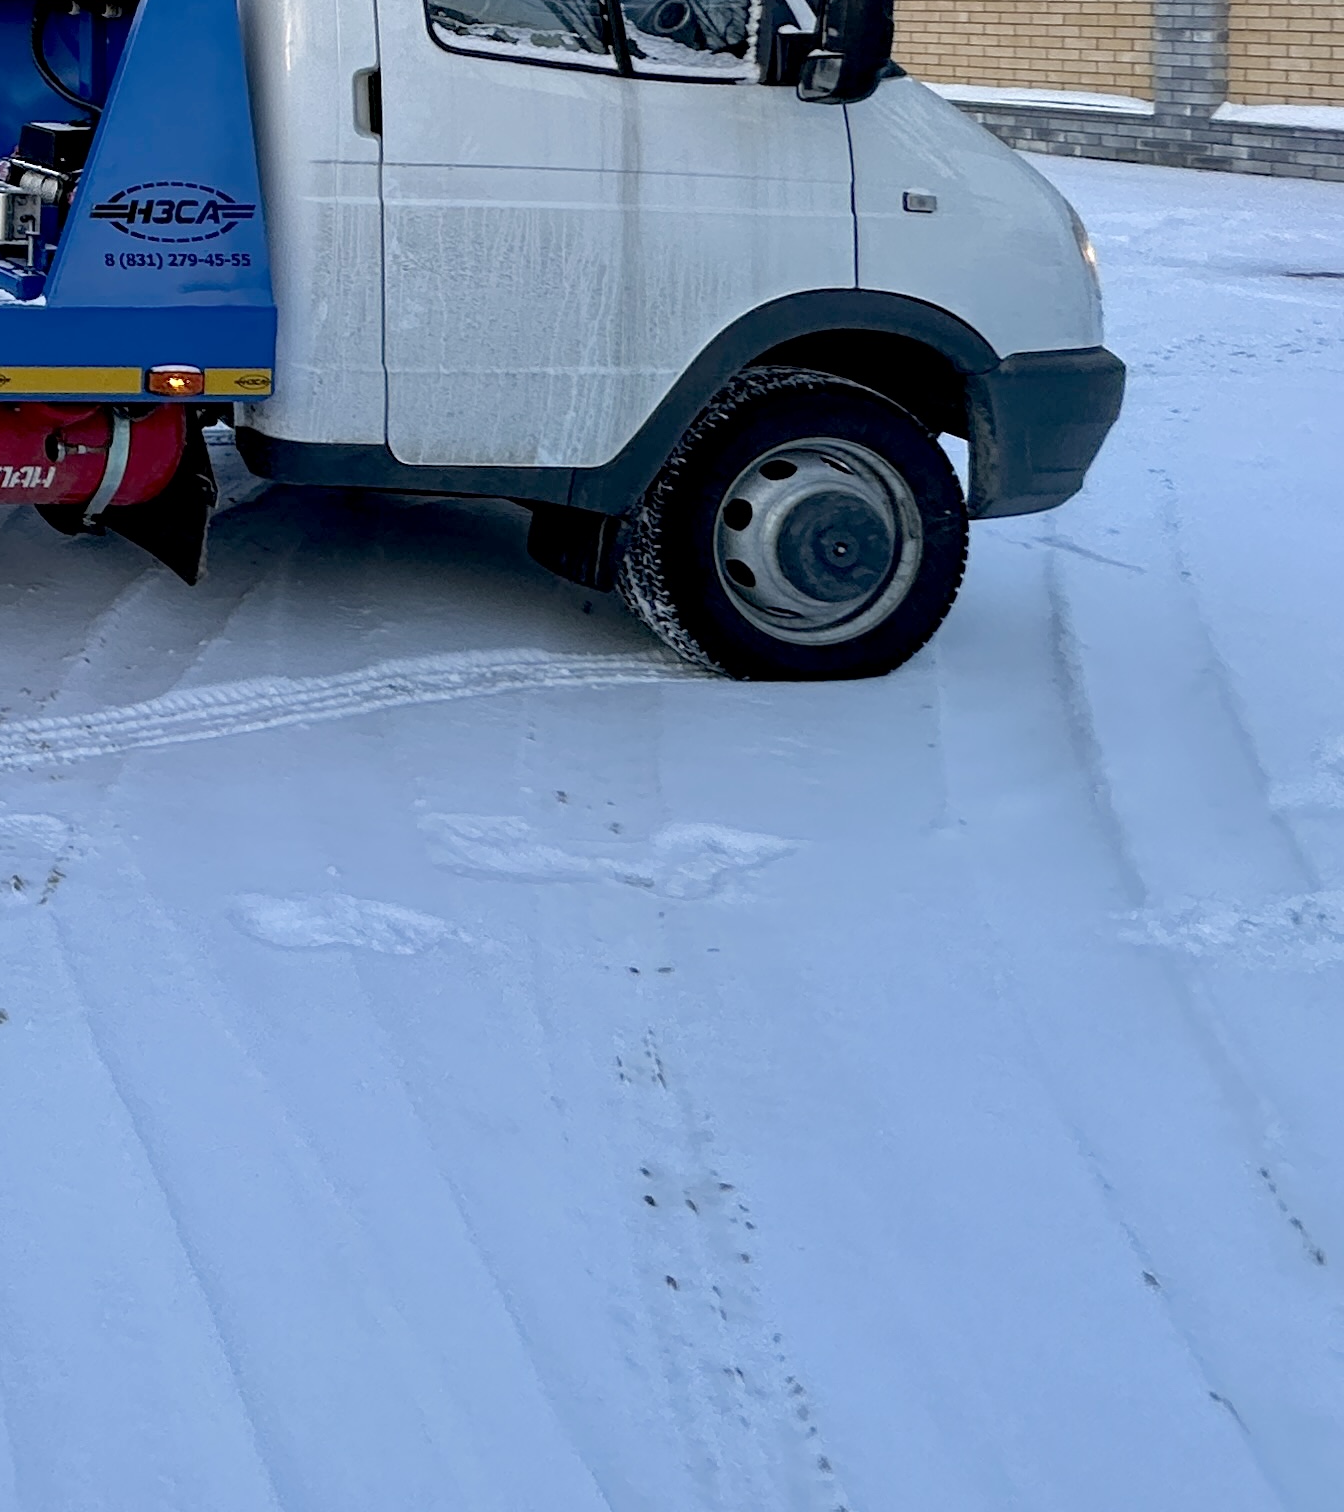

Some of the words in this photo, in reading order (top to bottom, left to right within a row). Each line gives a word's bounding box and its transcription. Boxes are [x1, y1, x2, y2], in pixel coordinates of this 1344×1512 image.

[126, 199, 221, 225] НЗСА
[104, 253, 115, 267] 8
[119, 252, 164, 270] (831)
[167, 253, 252, 267] 279-45-55
